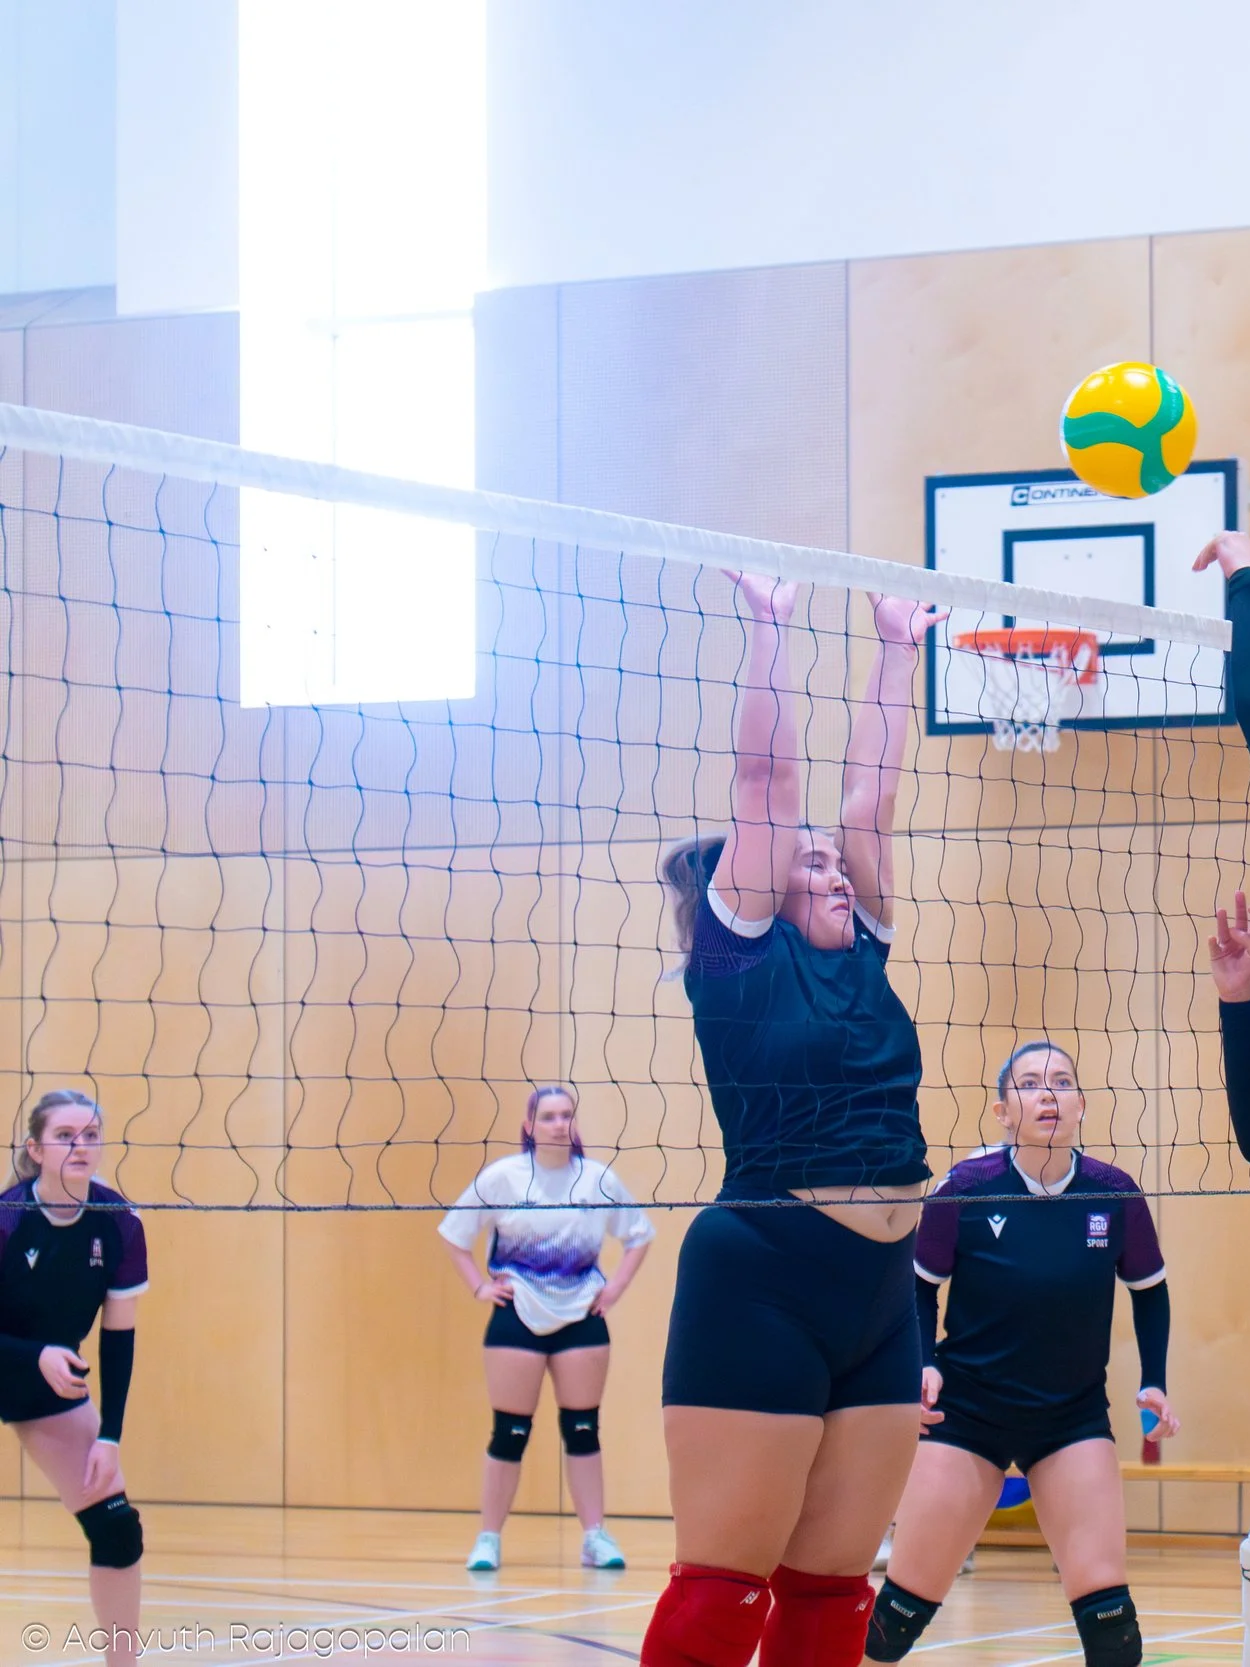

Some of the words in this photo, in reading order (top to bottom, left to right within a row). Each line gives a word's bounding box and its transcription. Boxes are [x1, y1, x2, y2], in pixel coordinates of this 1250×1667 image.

[1011, 486, 1098, 506] CONTINE
[1090, 1221, 1107, 1231] RGU
[1087, 1238, 1108, 1248] SPORT
